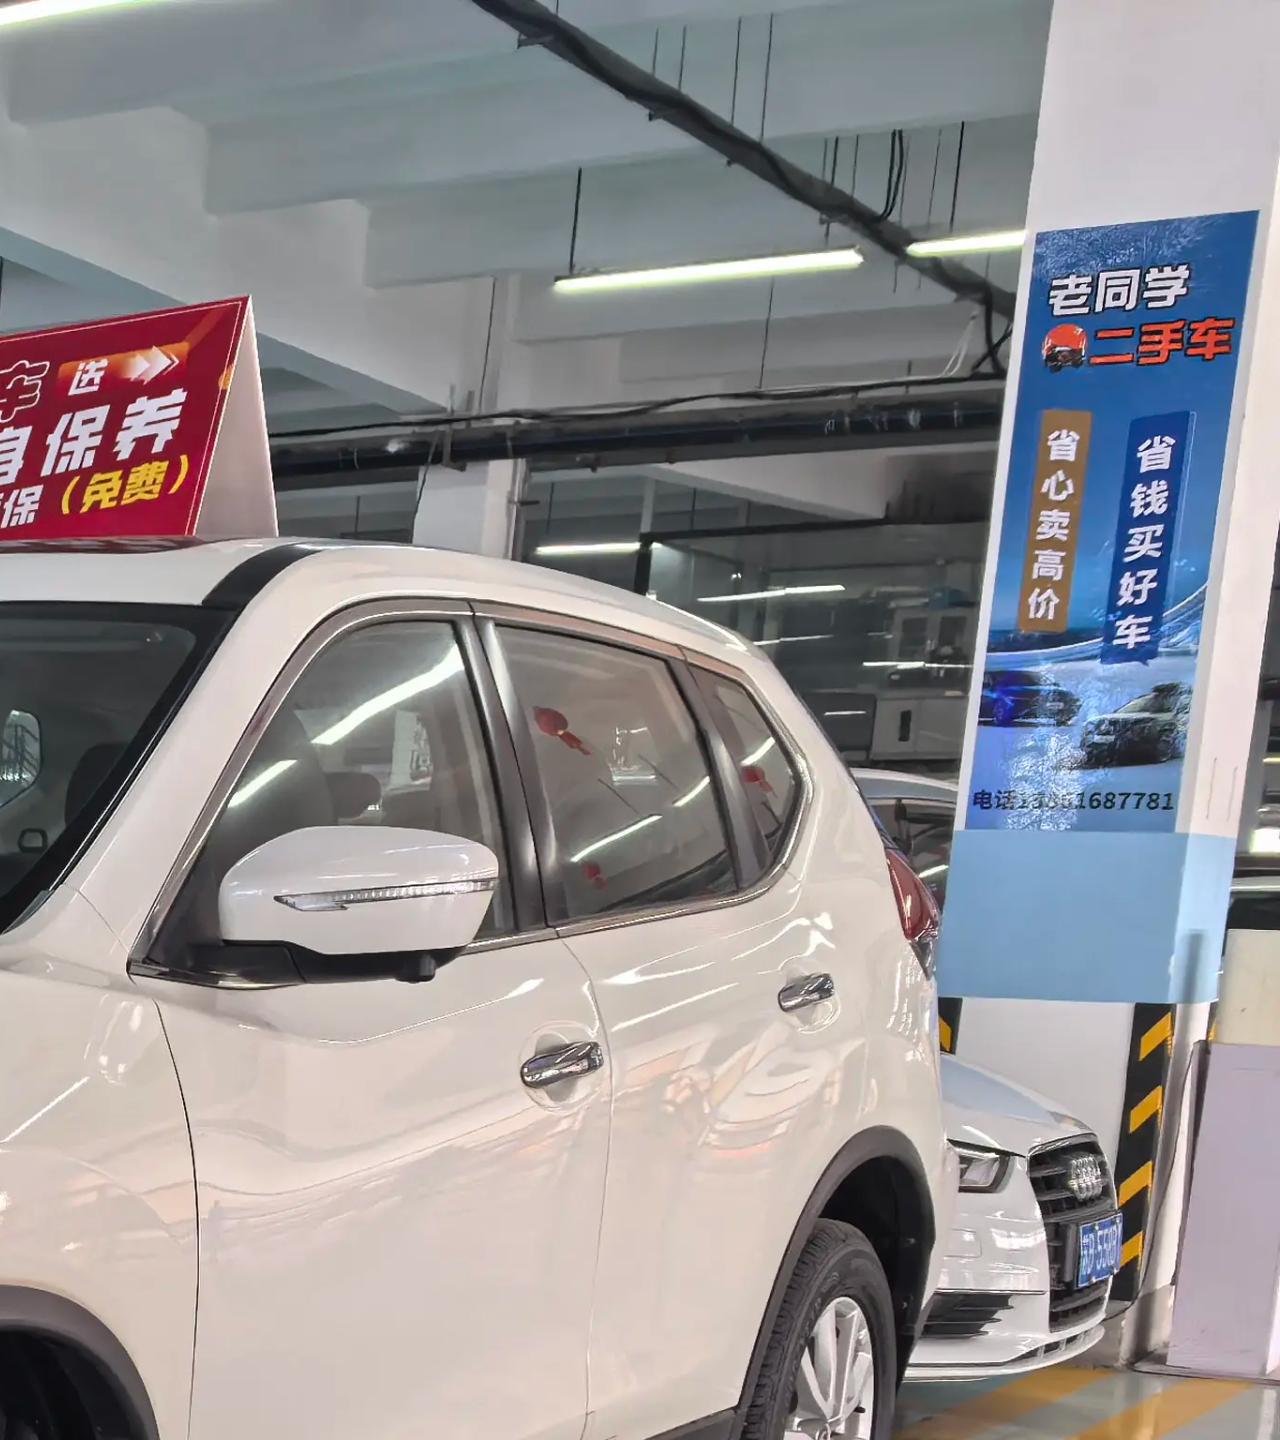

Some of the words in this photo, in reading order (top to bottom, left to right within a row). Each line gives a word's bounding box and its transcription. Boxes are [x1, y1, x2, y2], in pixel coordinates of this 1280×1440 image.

[1047, 264, 1190, 316] 老同学
[1089, 317, 1236, 365] 二手车
[68, 358, 110, 396] 送
[1027, 430, 1080, 621] 省心卖高价
[1112, 435, 1176, 650] 省钱买好车
